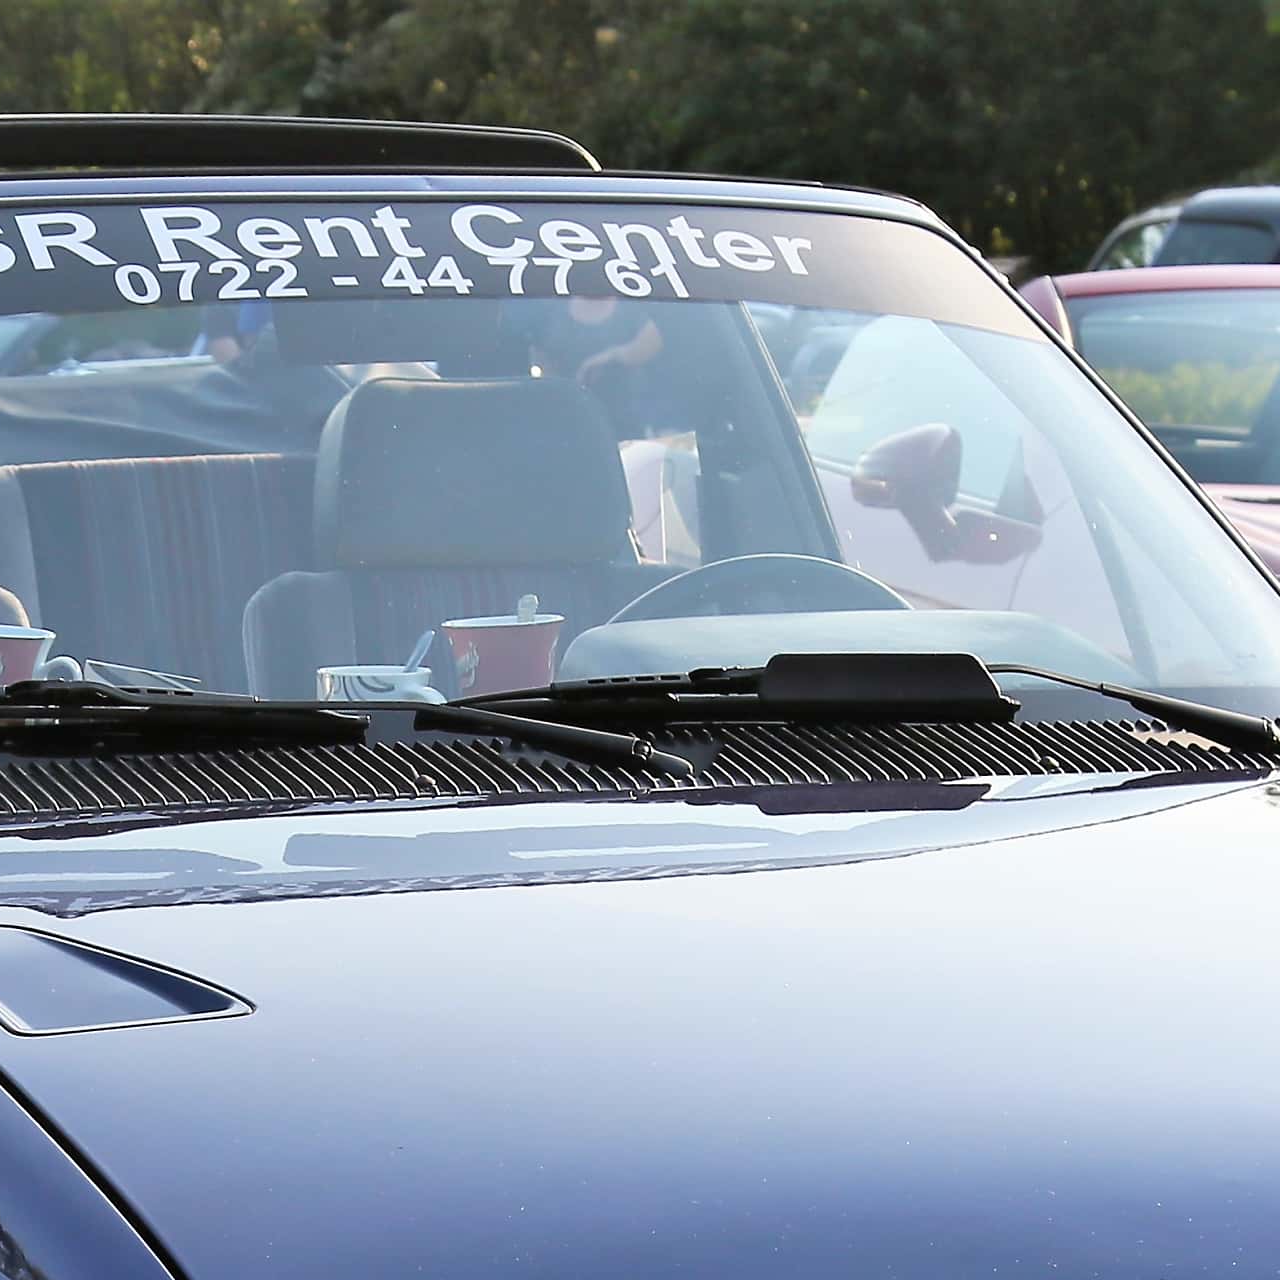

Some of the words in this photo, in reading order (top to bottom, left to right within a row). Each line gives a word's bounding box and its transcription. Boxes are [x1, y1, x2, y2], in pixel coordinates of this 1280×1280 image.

[139, 205, 426, 262] Rent
[450, 204, 813, 275] Center
[113, 259, 309, 305] 0722
[380, 255, 474, 295] 44
[486, 256, 574, 295] 77
[603, 258, 690, 298] 61
